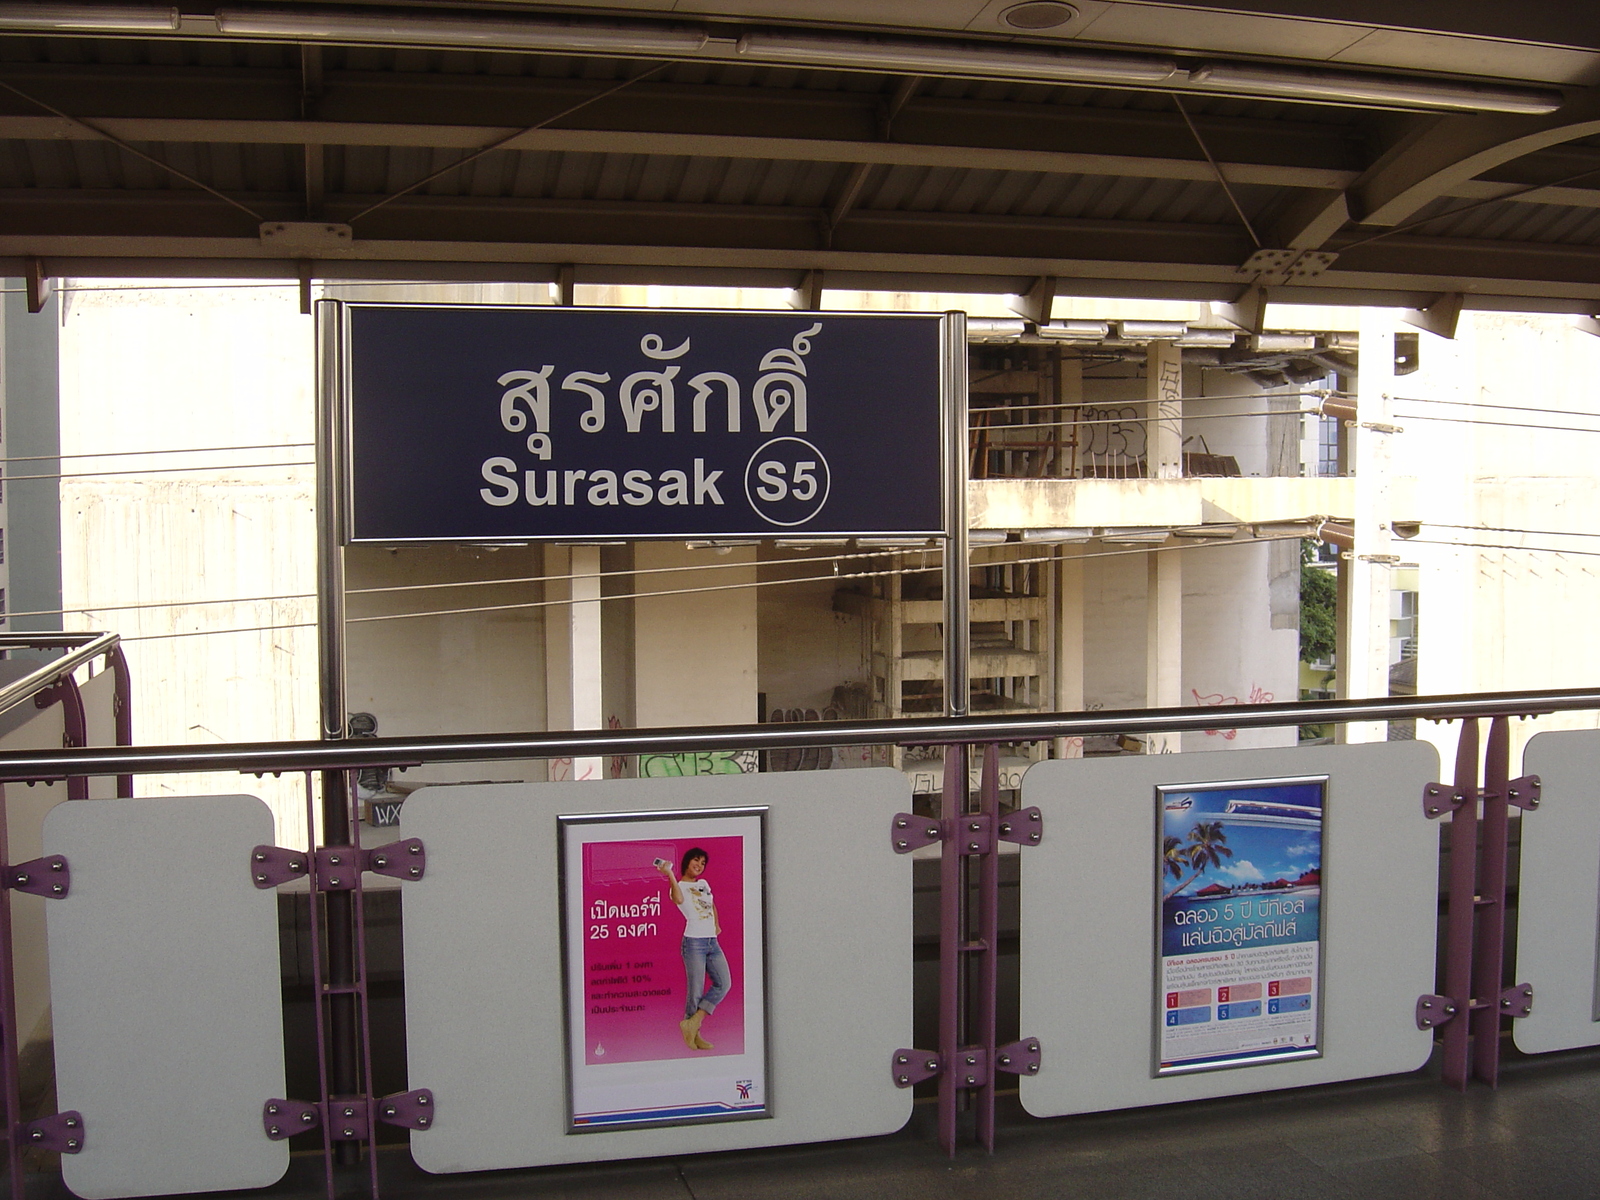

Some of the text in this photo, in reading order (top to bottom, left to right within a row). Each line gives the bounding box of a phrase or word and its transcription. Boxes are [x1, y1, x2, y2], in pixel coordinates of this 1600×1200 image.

[496, 322, 823, 461] สุรศักดิ์
[479, 456, 819, 507] Surasak S5
[590, 890, 661, 920] เปิดแอร์ที่
[1174, 898, 1305, 926] ฉลอง 5 ปี บีทีเอส
[590, 922, 657, 940] 25 องศา
[631, 974, 652, 984] 10%
[1271, 986, 1277, 995] 3
[1221, 993, 1227, 1001] 2
[1271, 1004, 1277, 1012] 6
[1221, 1010, 1227, 1018] 5
[1169, 1015, 1175, 1024] 4
